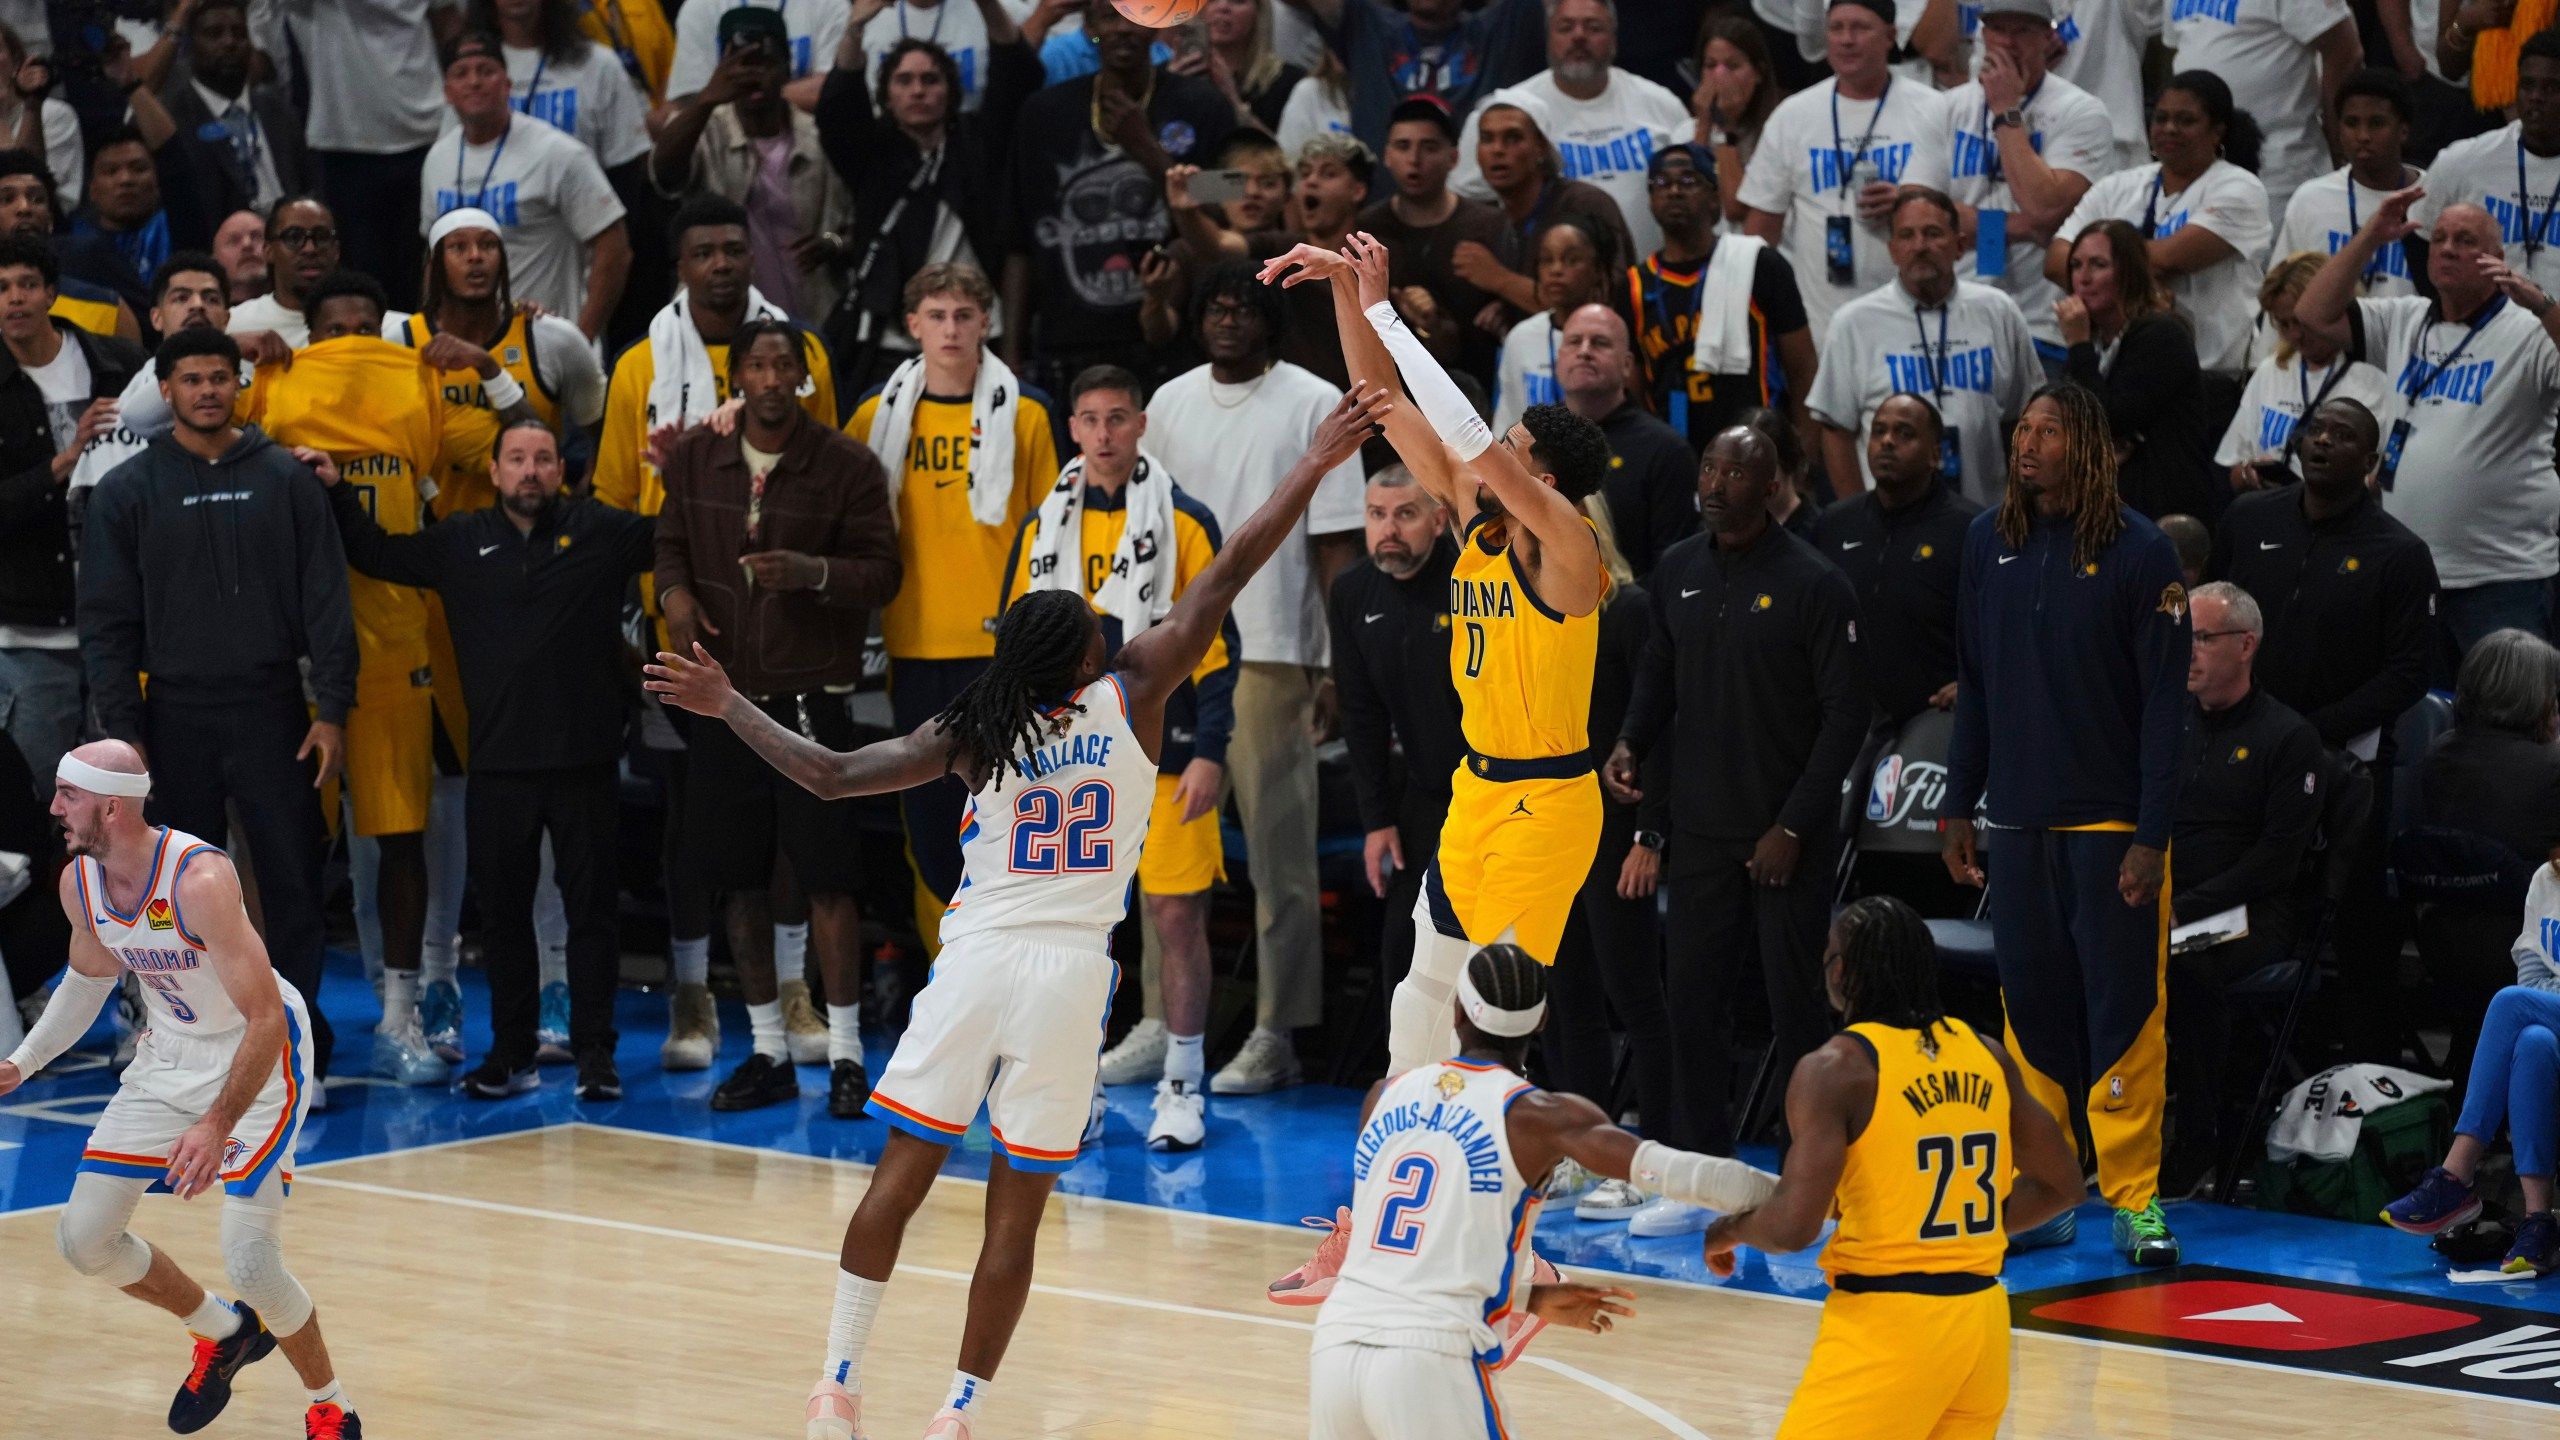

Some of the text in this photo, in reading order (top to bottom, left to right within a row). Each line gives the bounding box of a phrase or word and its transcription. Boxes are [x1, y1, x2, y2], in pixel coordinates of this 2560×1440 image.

[1465, 621, 1486, 678] 0
[1018, 734, 1113, 782] WALLACE
[1008, 779, 1115, 875] 22
[1902, 1070, 1993, 1118] NESMITH
[1371, 1151, 1441, 1257] 2
[1917, 1131, 1998, 1240] 23
